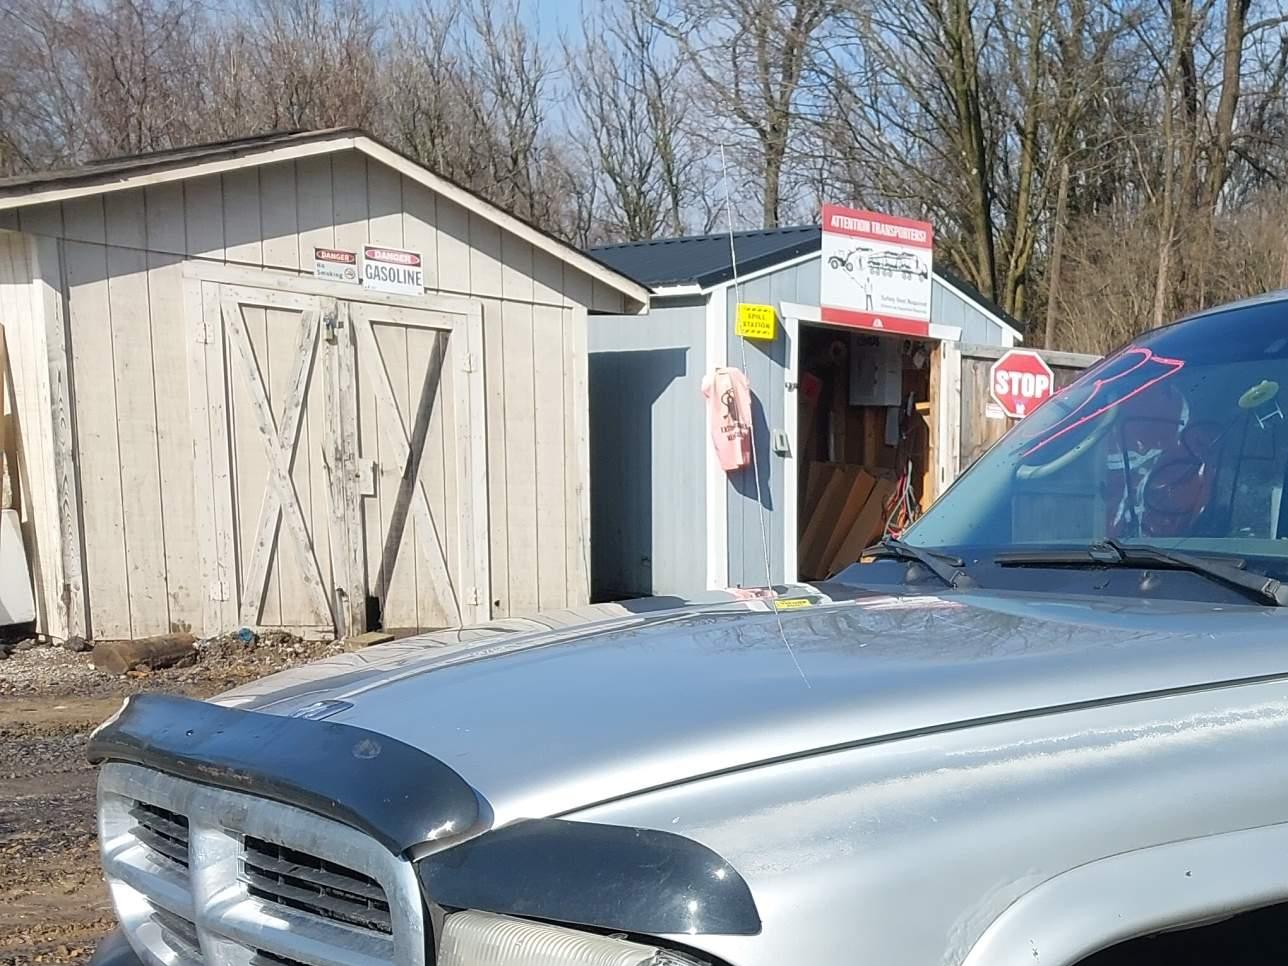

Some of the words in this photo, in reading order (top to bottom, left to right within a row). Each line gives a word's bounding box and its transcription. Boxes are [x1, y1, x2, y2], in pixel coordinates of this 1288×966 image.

[831, 215, 871, 233] ATTENTION
[871, 221, 927, 242] TRANSPORTERS!
[321, 248, 350, 261] DANGER
[373, 249, 413, 261] DANGER
[365, 263, 423, 287] GASOLINE
[747, 313, 766, 321] SPILL
[742, 321, 771, 329] STATION
[995, 369, 1050, 399] STOP
